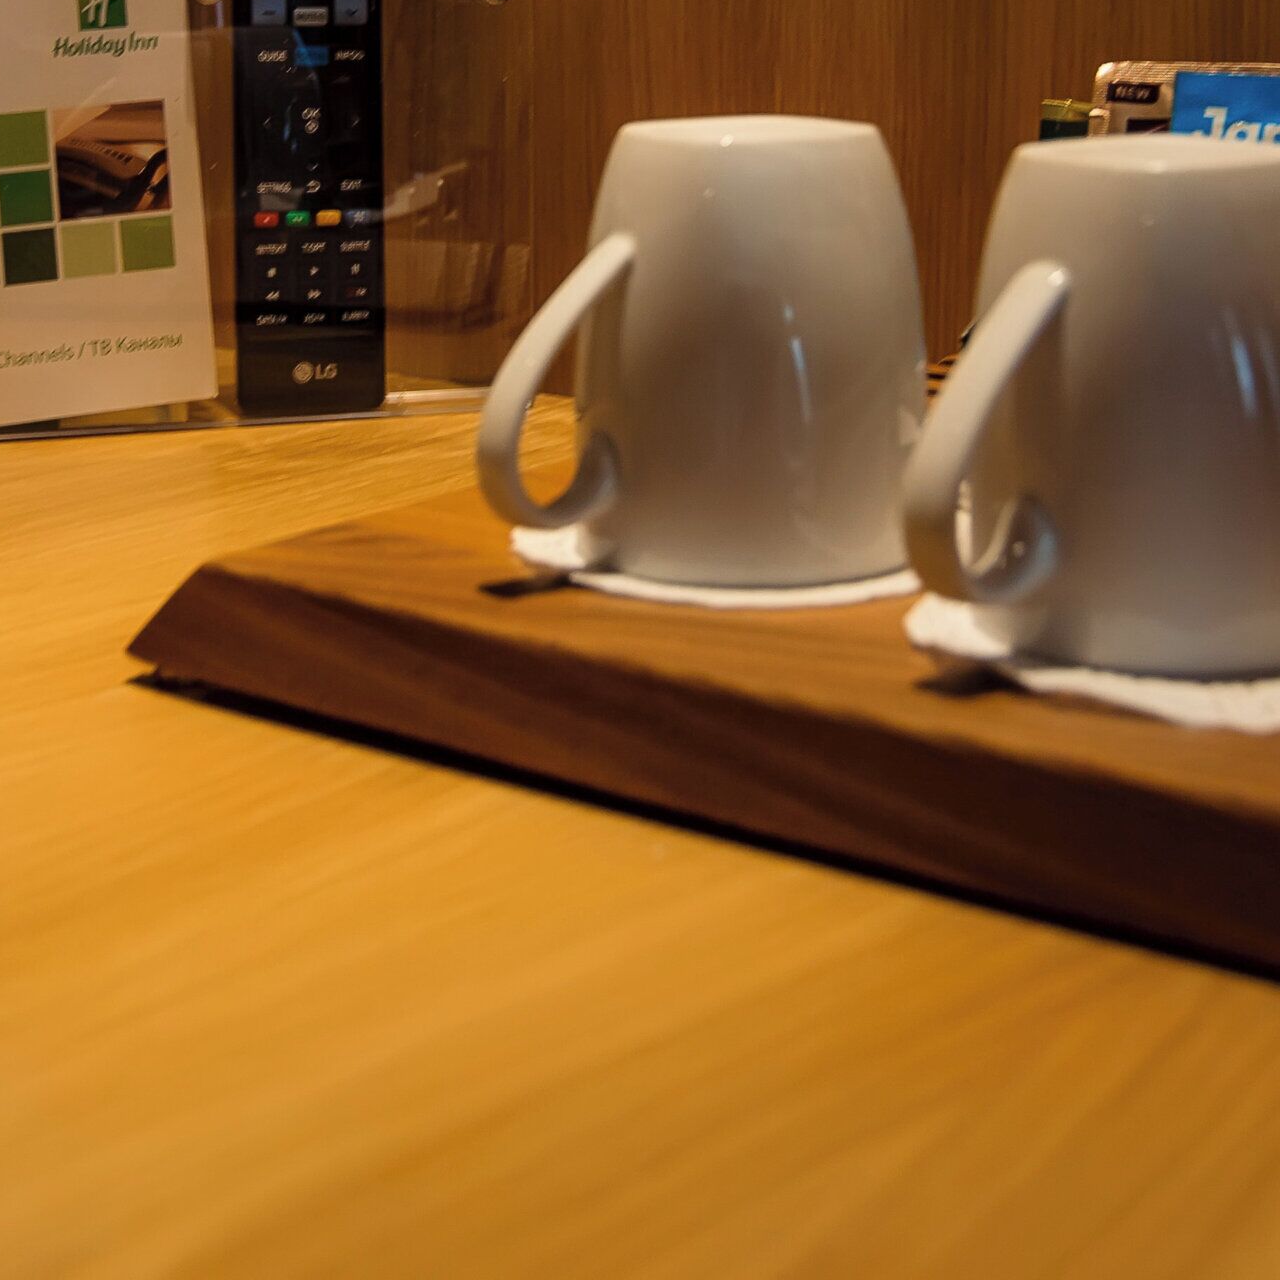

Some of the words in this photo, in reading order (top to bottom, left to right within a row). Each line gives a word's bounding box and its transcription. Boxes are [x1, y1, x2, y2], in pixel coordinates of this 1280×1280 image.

[52, 34, 127, 58] Holiday
[128, 31, 159, 52] Inn
[1114, 84, 1152, 99] NEW
[116, 333, 184, 353] Каналы
[315, 362, 338, 381] LG
